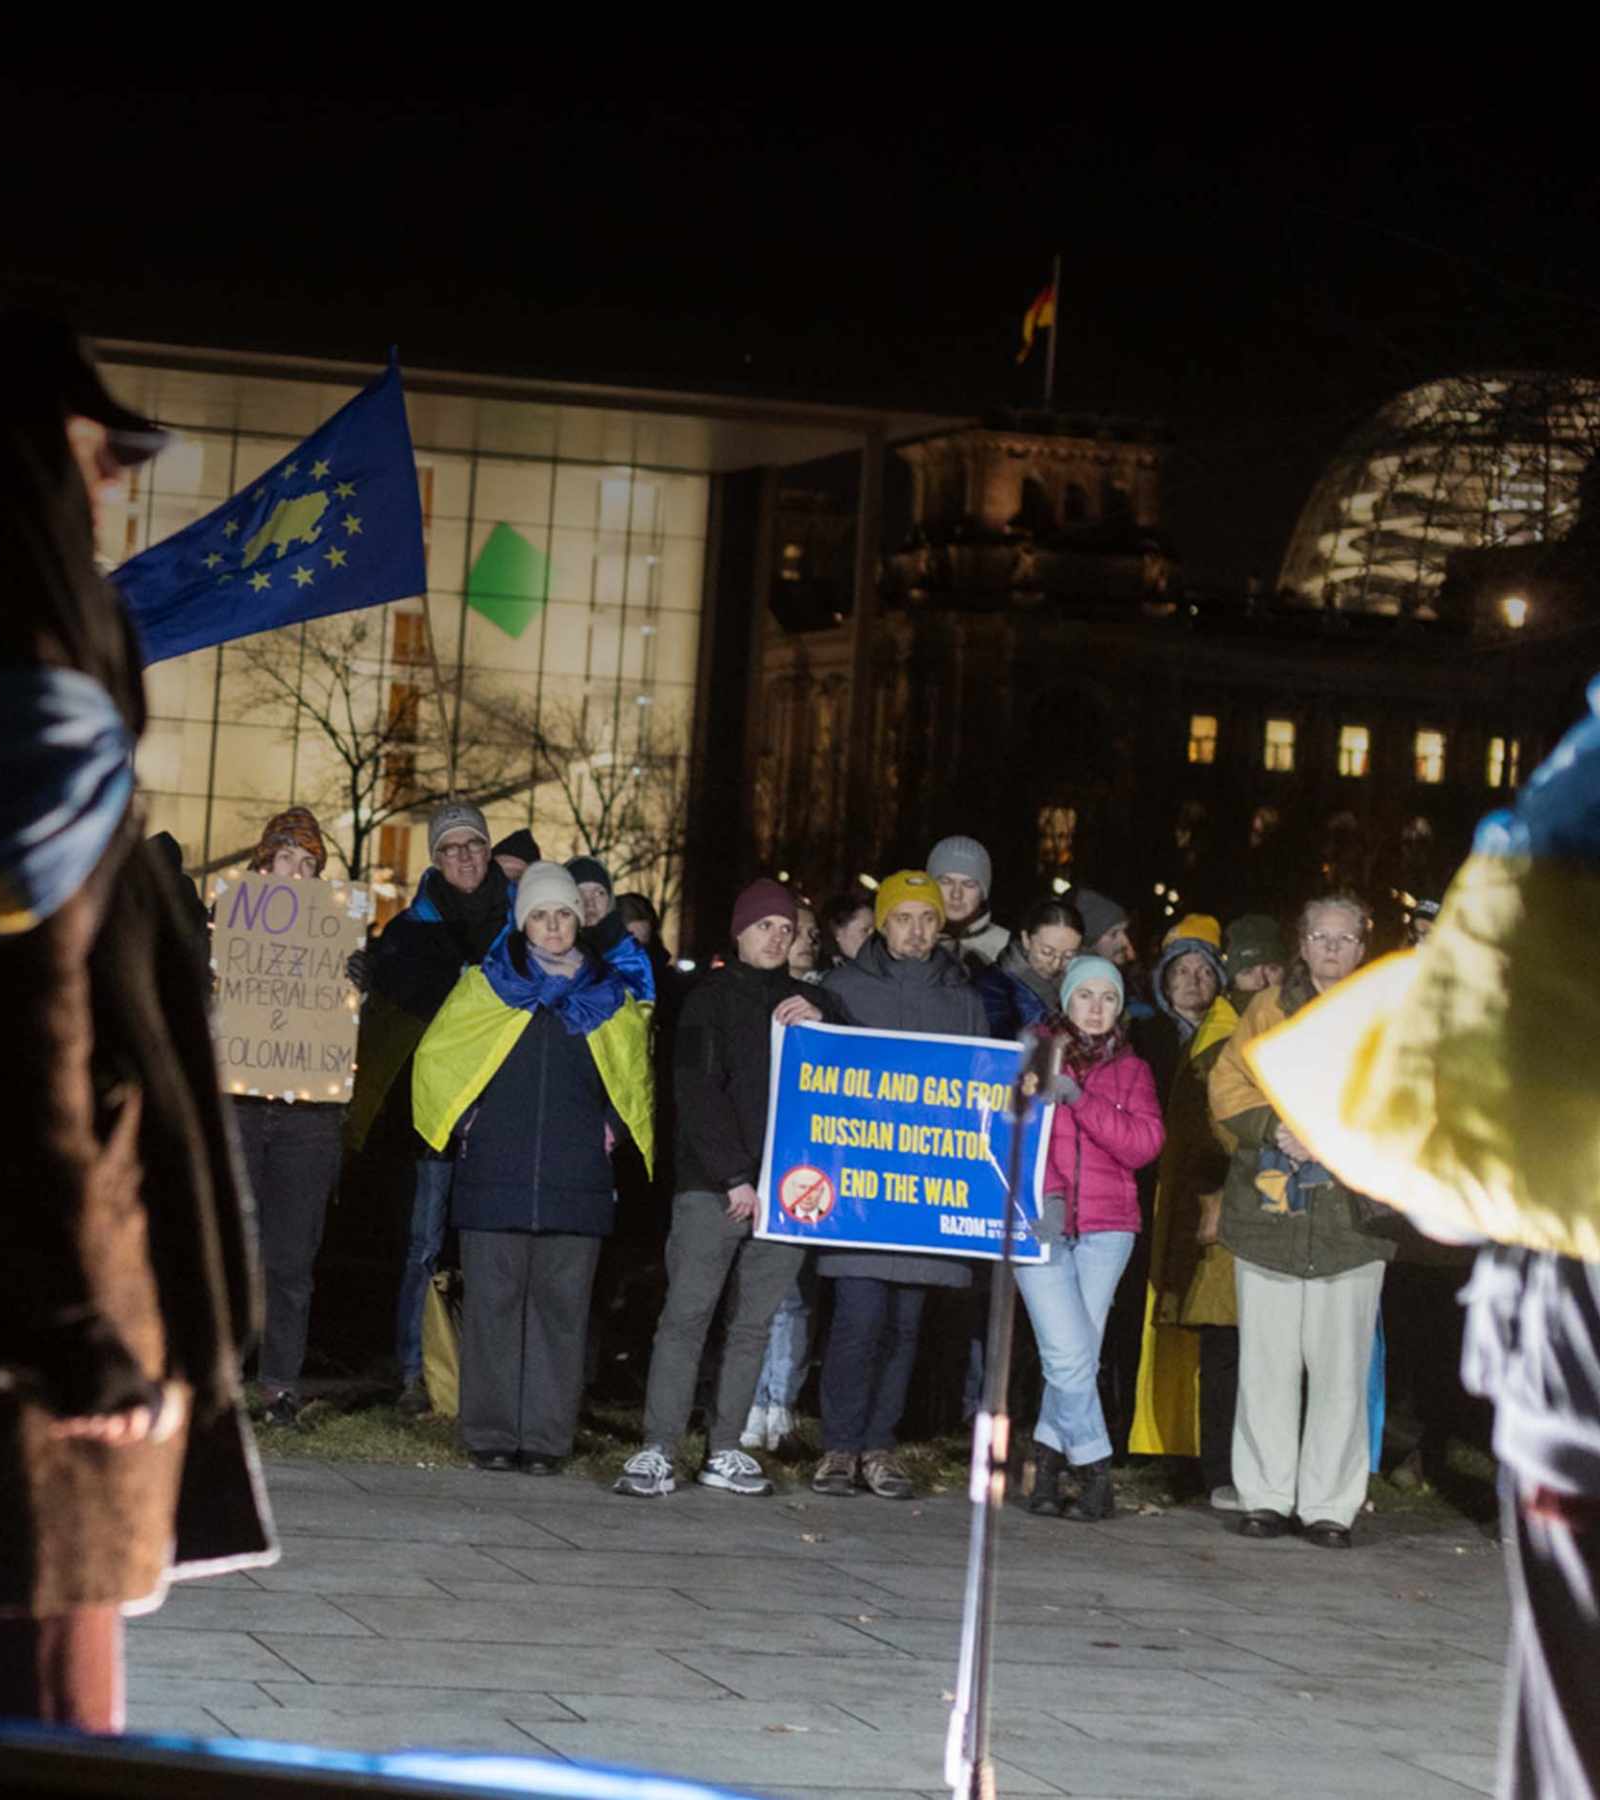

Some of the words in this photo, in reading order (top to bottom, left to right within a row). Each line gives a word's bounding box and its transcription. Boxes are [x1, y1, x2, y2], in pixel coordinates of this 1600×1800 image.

[227, 880, 299, 935] NO
[270, 1008, 288, 1033] &
[799, 1062, 839, 1095] BAN
[843, 1069, 873, 1099] OIL
[877, 1072, 919, 1104] AND
[923, 1076, 963, 1110] GAS
[810, 1114, 894, 1151] RUSSIAN
[840, 1168, 878, 1200] END
[883, 1172, 919, 1204] THE
[924, 1178, 969, 1208] WAR
[940, 1213, 986, 1238] RAZOM
